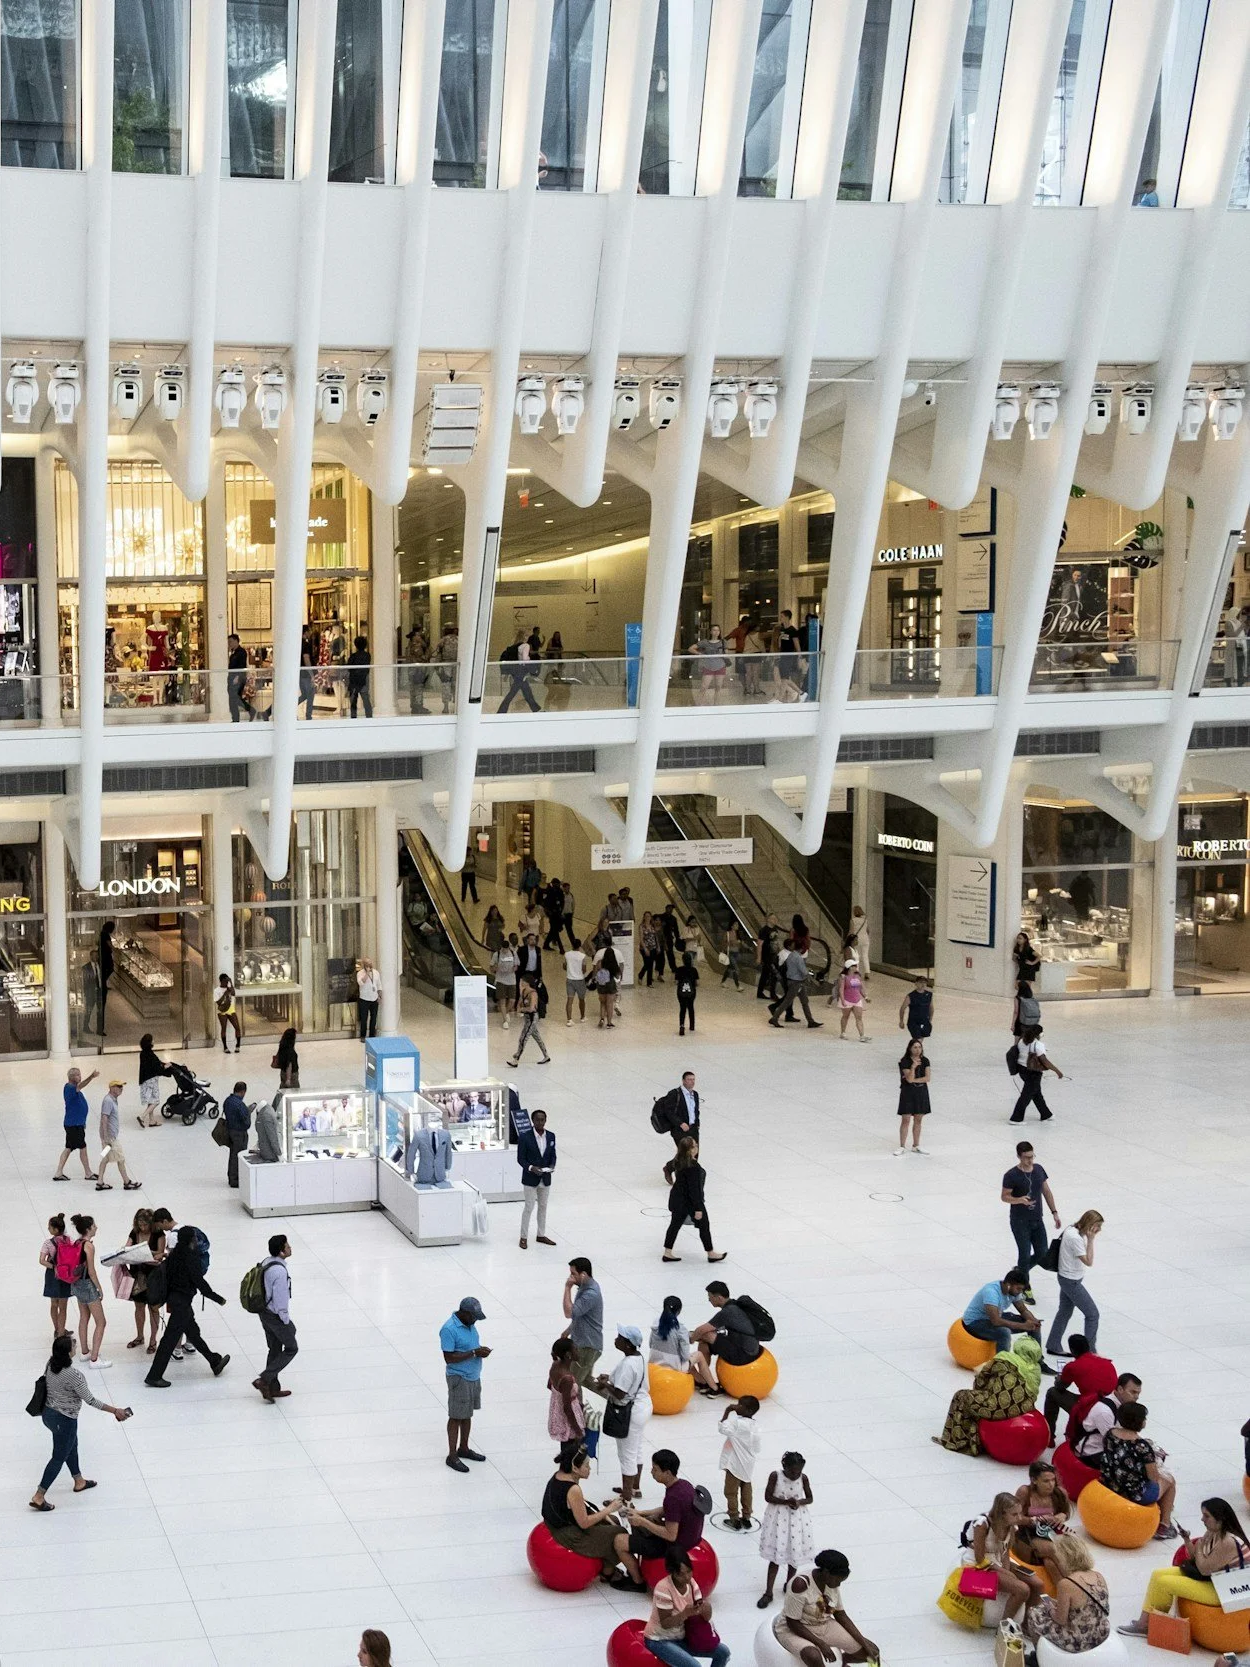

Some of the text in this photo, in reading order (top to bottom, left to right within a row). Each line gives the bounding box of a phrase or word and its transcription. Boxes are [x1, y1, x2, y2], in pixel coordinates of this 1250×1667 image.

[308, 517, 328, 527] ade
[878, 544, 944, 563] COLE HAAN
[1039, 600, 1108, 640] Pinch
[878, 833, 935, 853] ROBERTO COIN
[1193, 838, 1250, 853] ROBERTO
[99, 877, 181, 897] LONDON
[1229, 1584, 1250, 1595] MoM
